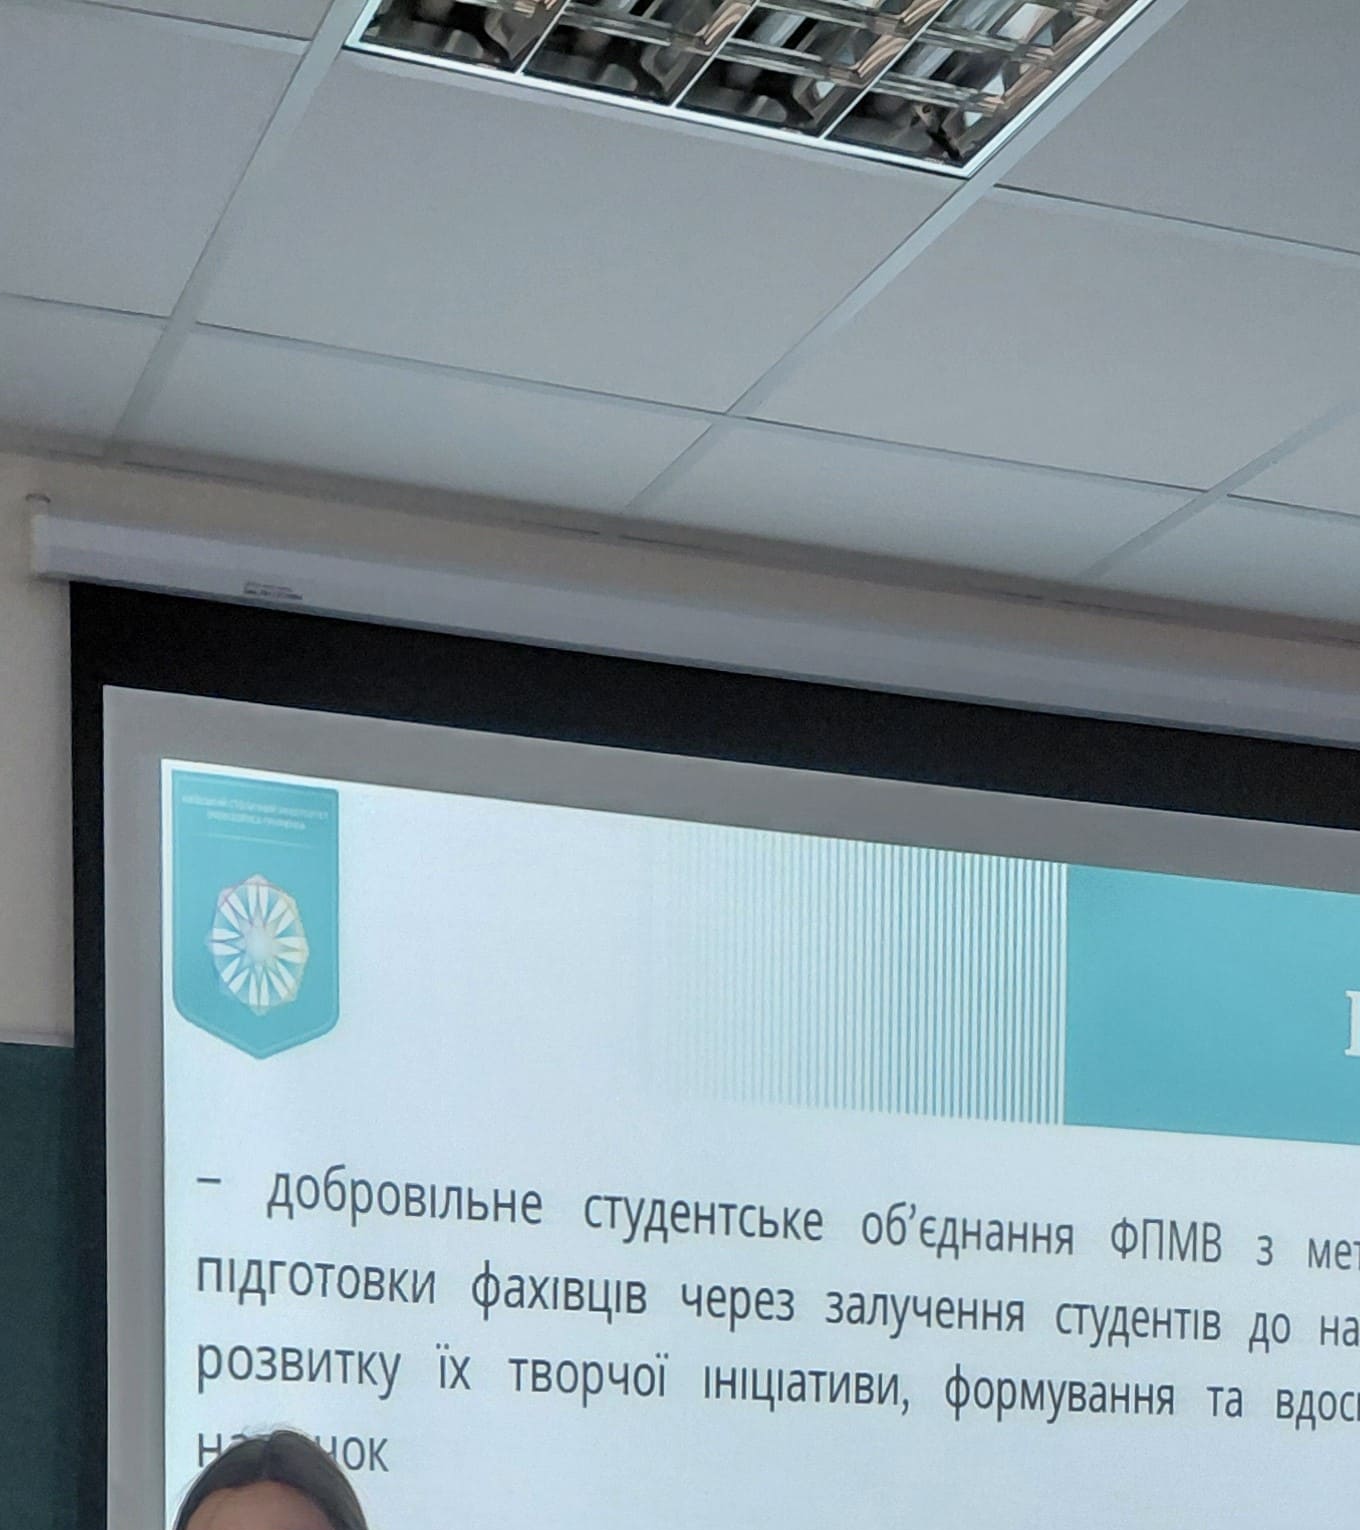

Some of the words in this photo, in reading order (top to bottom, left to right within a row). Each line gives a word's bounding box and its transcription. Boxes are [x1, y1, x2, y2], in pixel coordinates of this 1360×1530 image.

[266, 1163, 543, 1228] добровільне
[584, 1194, 824, 1245] студентське
[1110, 1216, 1222, 1263] ФПМВ
[1255, 1234, 1274, 1267] з
[197, 1256, 436, 1307] підготовки
[471, 1259, 648, 1326] фахівців
[681, 1283, 795, 1334] через
[824, 1291, 1025, 1340] залучення
[1055, 1302, 1222, 1349] студентів
[1248, 1311, 1291, 1355] до
[197, 1343, 402, 1401] розвитку
[435, 1342, 472, 1391] їх
[507, 1351, 669, 1409] творчої
[704, 1365, 910, 1417] ініціативи,
[944, 1362, 1175, 1425] формування
[1205, 1386, 1243, 1419] та
